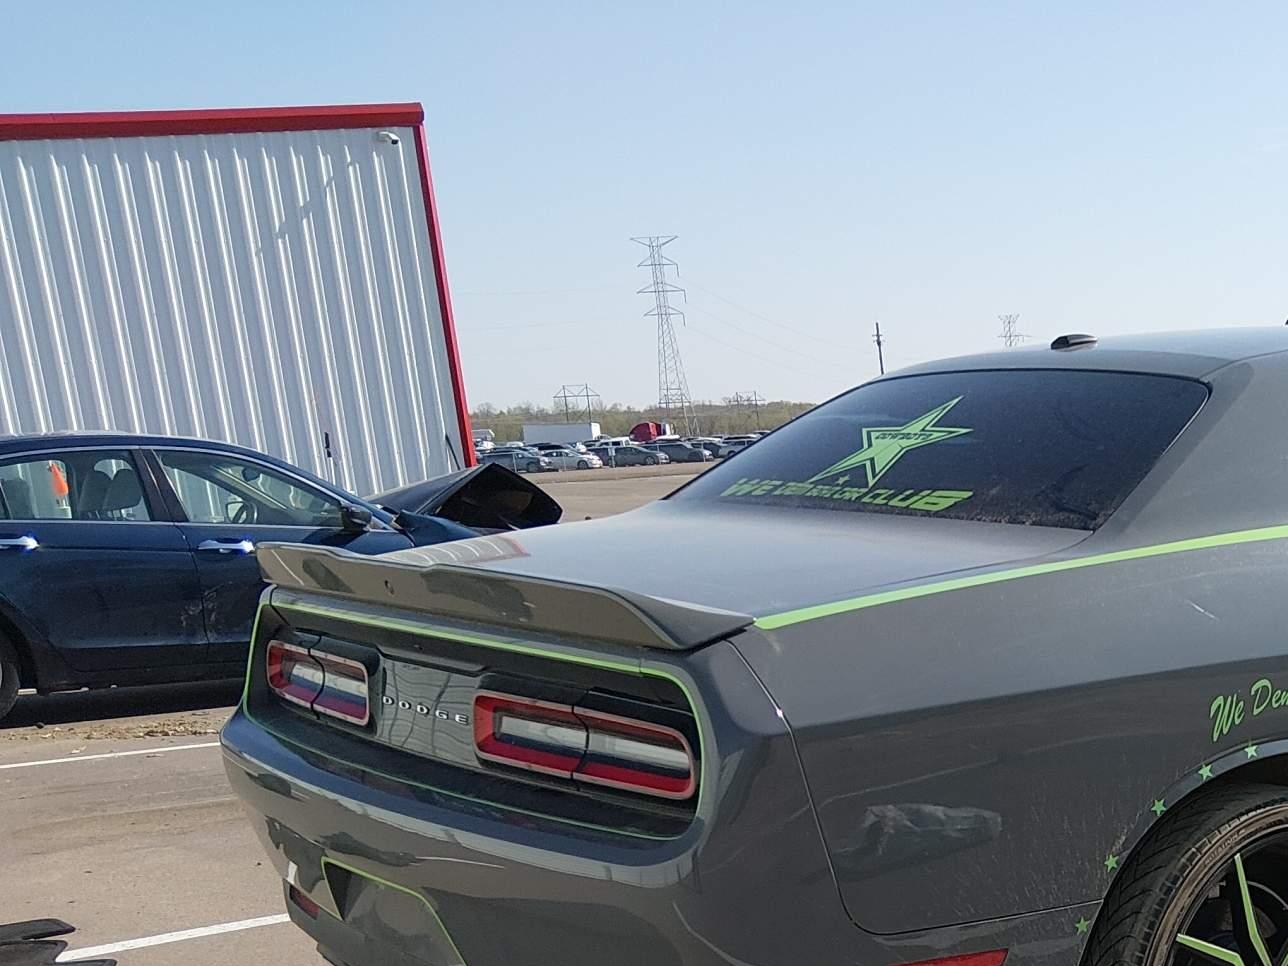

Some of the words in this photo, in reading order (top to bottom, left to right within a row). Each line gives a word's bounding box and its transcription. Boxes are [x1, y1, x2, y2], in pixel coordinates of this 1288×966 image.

[720, 478, 784, 497] WE
[861, 489, 975, 512] CLUB
[383, 696, 468, 725] DODGE
[1209, 694, 1246, 743] We
